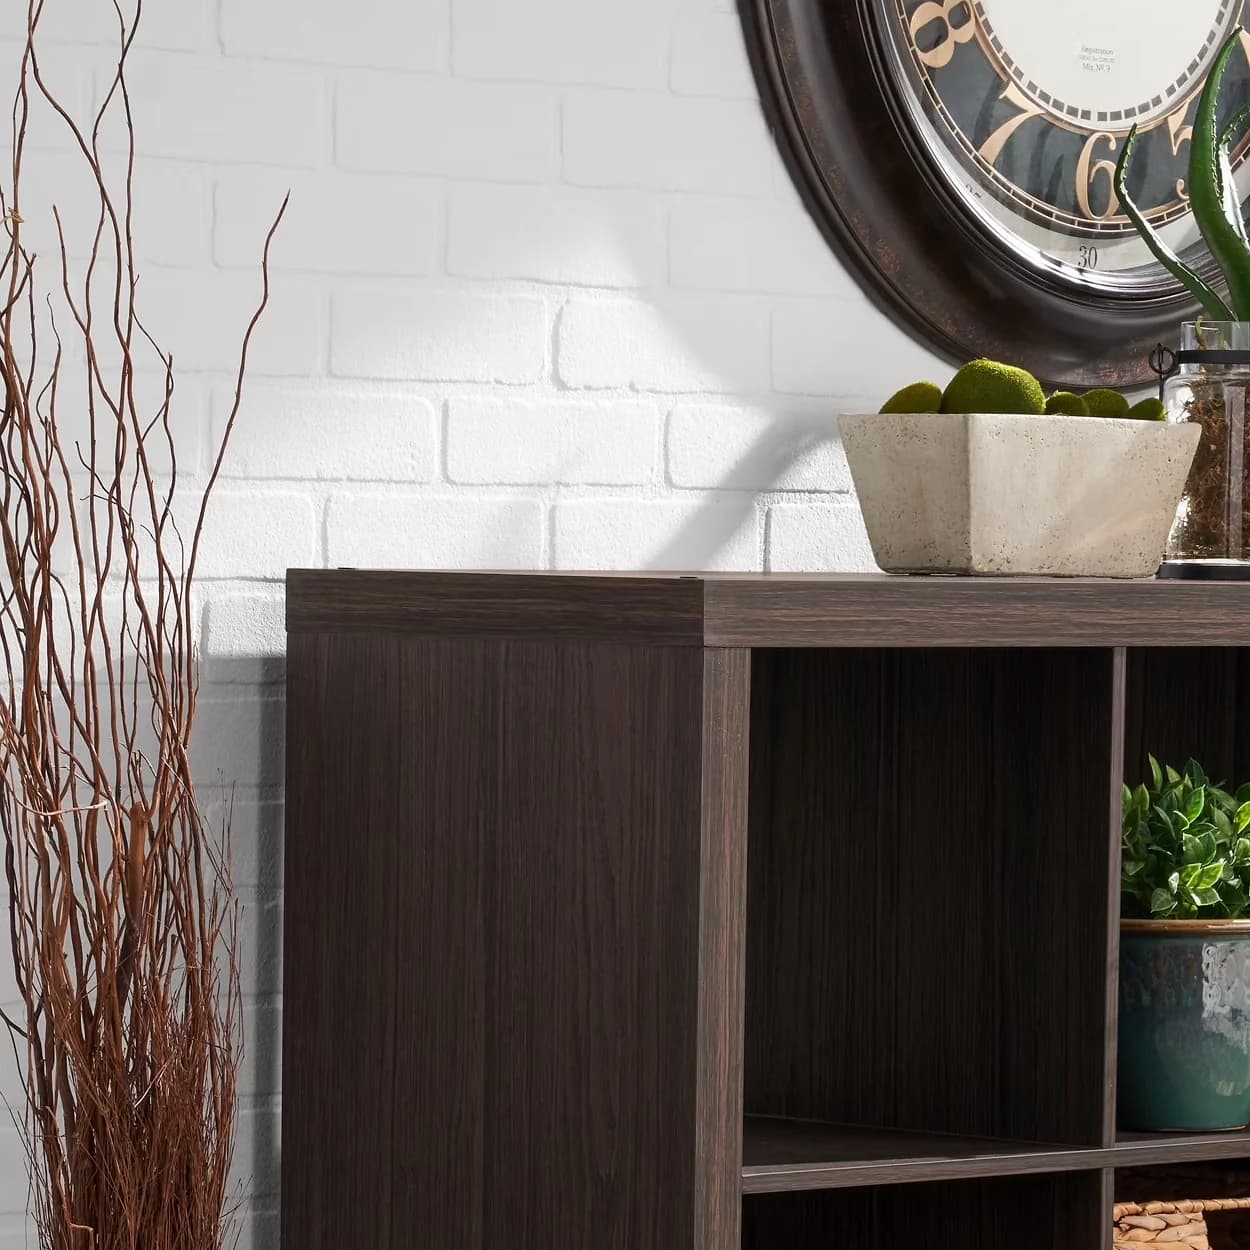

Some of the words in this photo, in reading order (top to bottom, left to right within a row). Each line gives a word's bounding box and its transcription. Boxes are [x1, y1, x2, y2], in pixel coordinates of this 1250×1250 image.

[910, 0, 976, 68] 8
[977, 81, 1046, 167] 7
[1076, 132, 1120, 220] 6
[1078, 246, 1098, 269] 30
